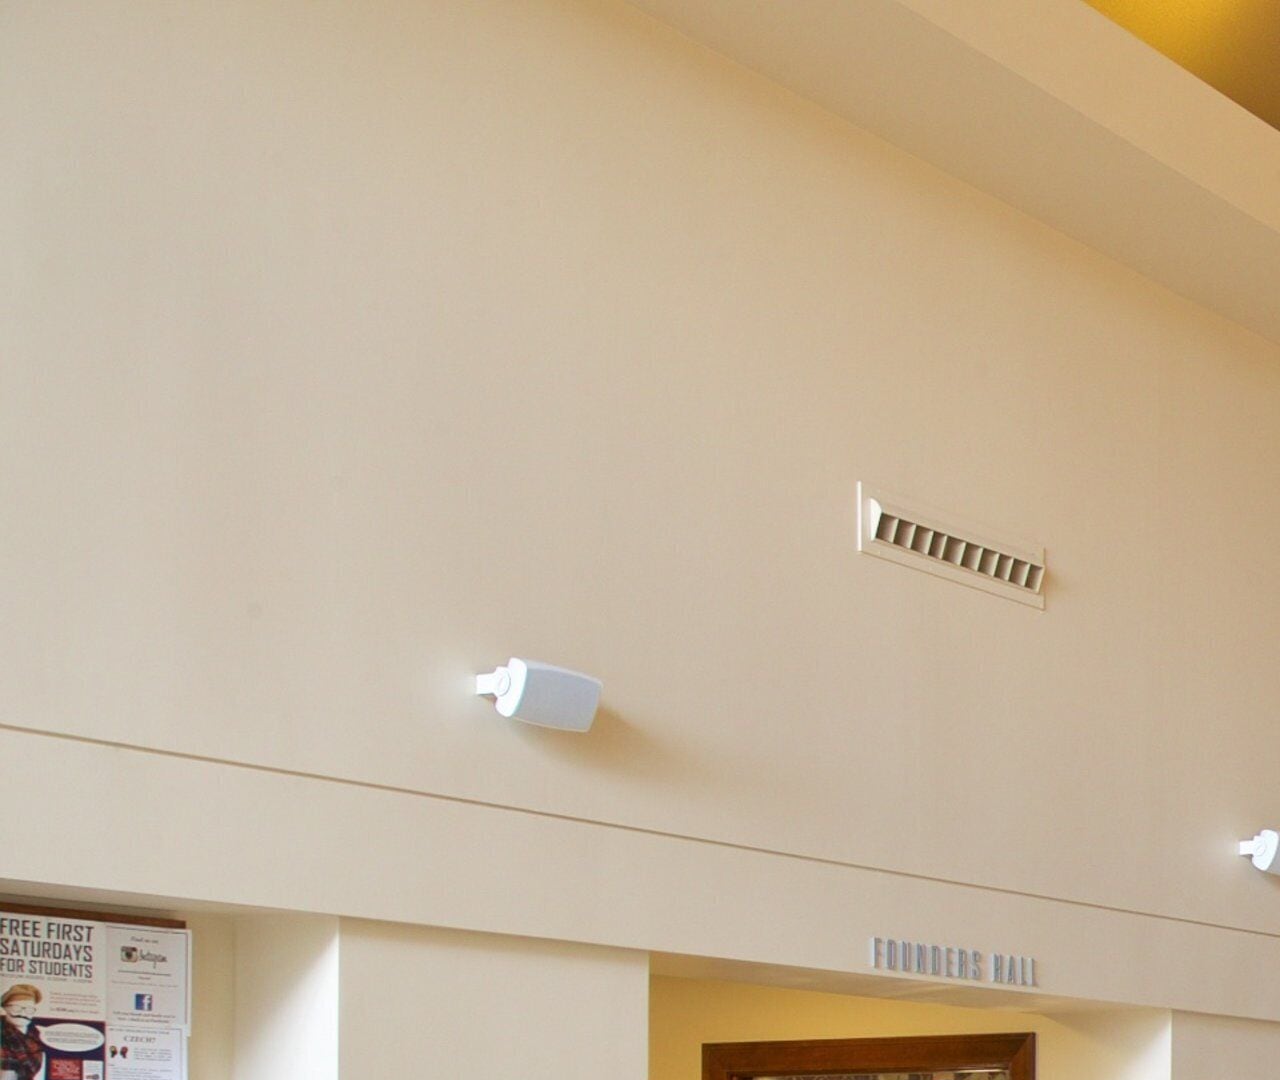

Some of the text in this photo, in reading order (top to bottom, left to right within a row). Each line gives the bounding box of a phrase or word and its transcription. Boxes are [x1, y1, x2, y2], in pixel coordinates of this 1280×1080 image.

[0, 918, 94, 942] FREE FIRST
[0, 938, 93, 962] SATURDAYS
[869, 937, 1038, 987] FOUNDERS HALL
[0, 958, 25, 973] FOR
[29, 960, 93, 979] STUDENTS
